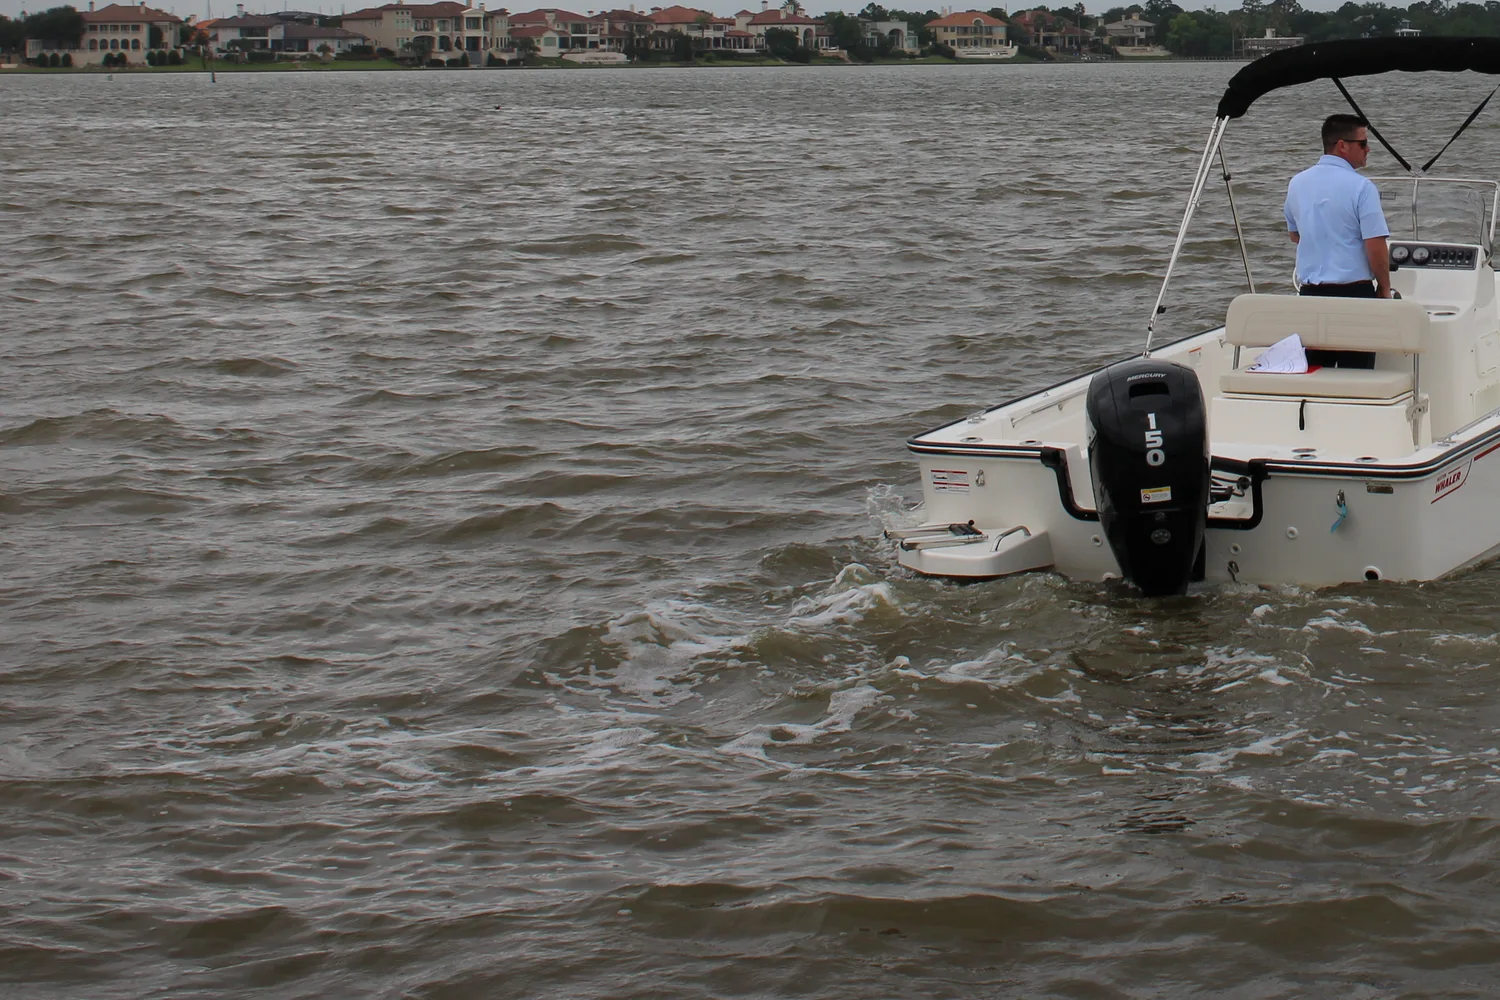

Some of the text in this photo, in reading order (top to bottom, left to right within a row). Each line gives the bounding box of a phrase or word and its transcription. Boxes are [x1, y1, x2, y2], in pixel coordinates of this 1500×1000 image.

[1127, 372, 1166, 382] MERCURY
[1145, 412, 1165, 466] 150
[1435, 471, 1462, 494] WHALER
